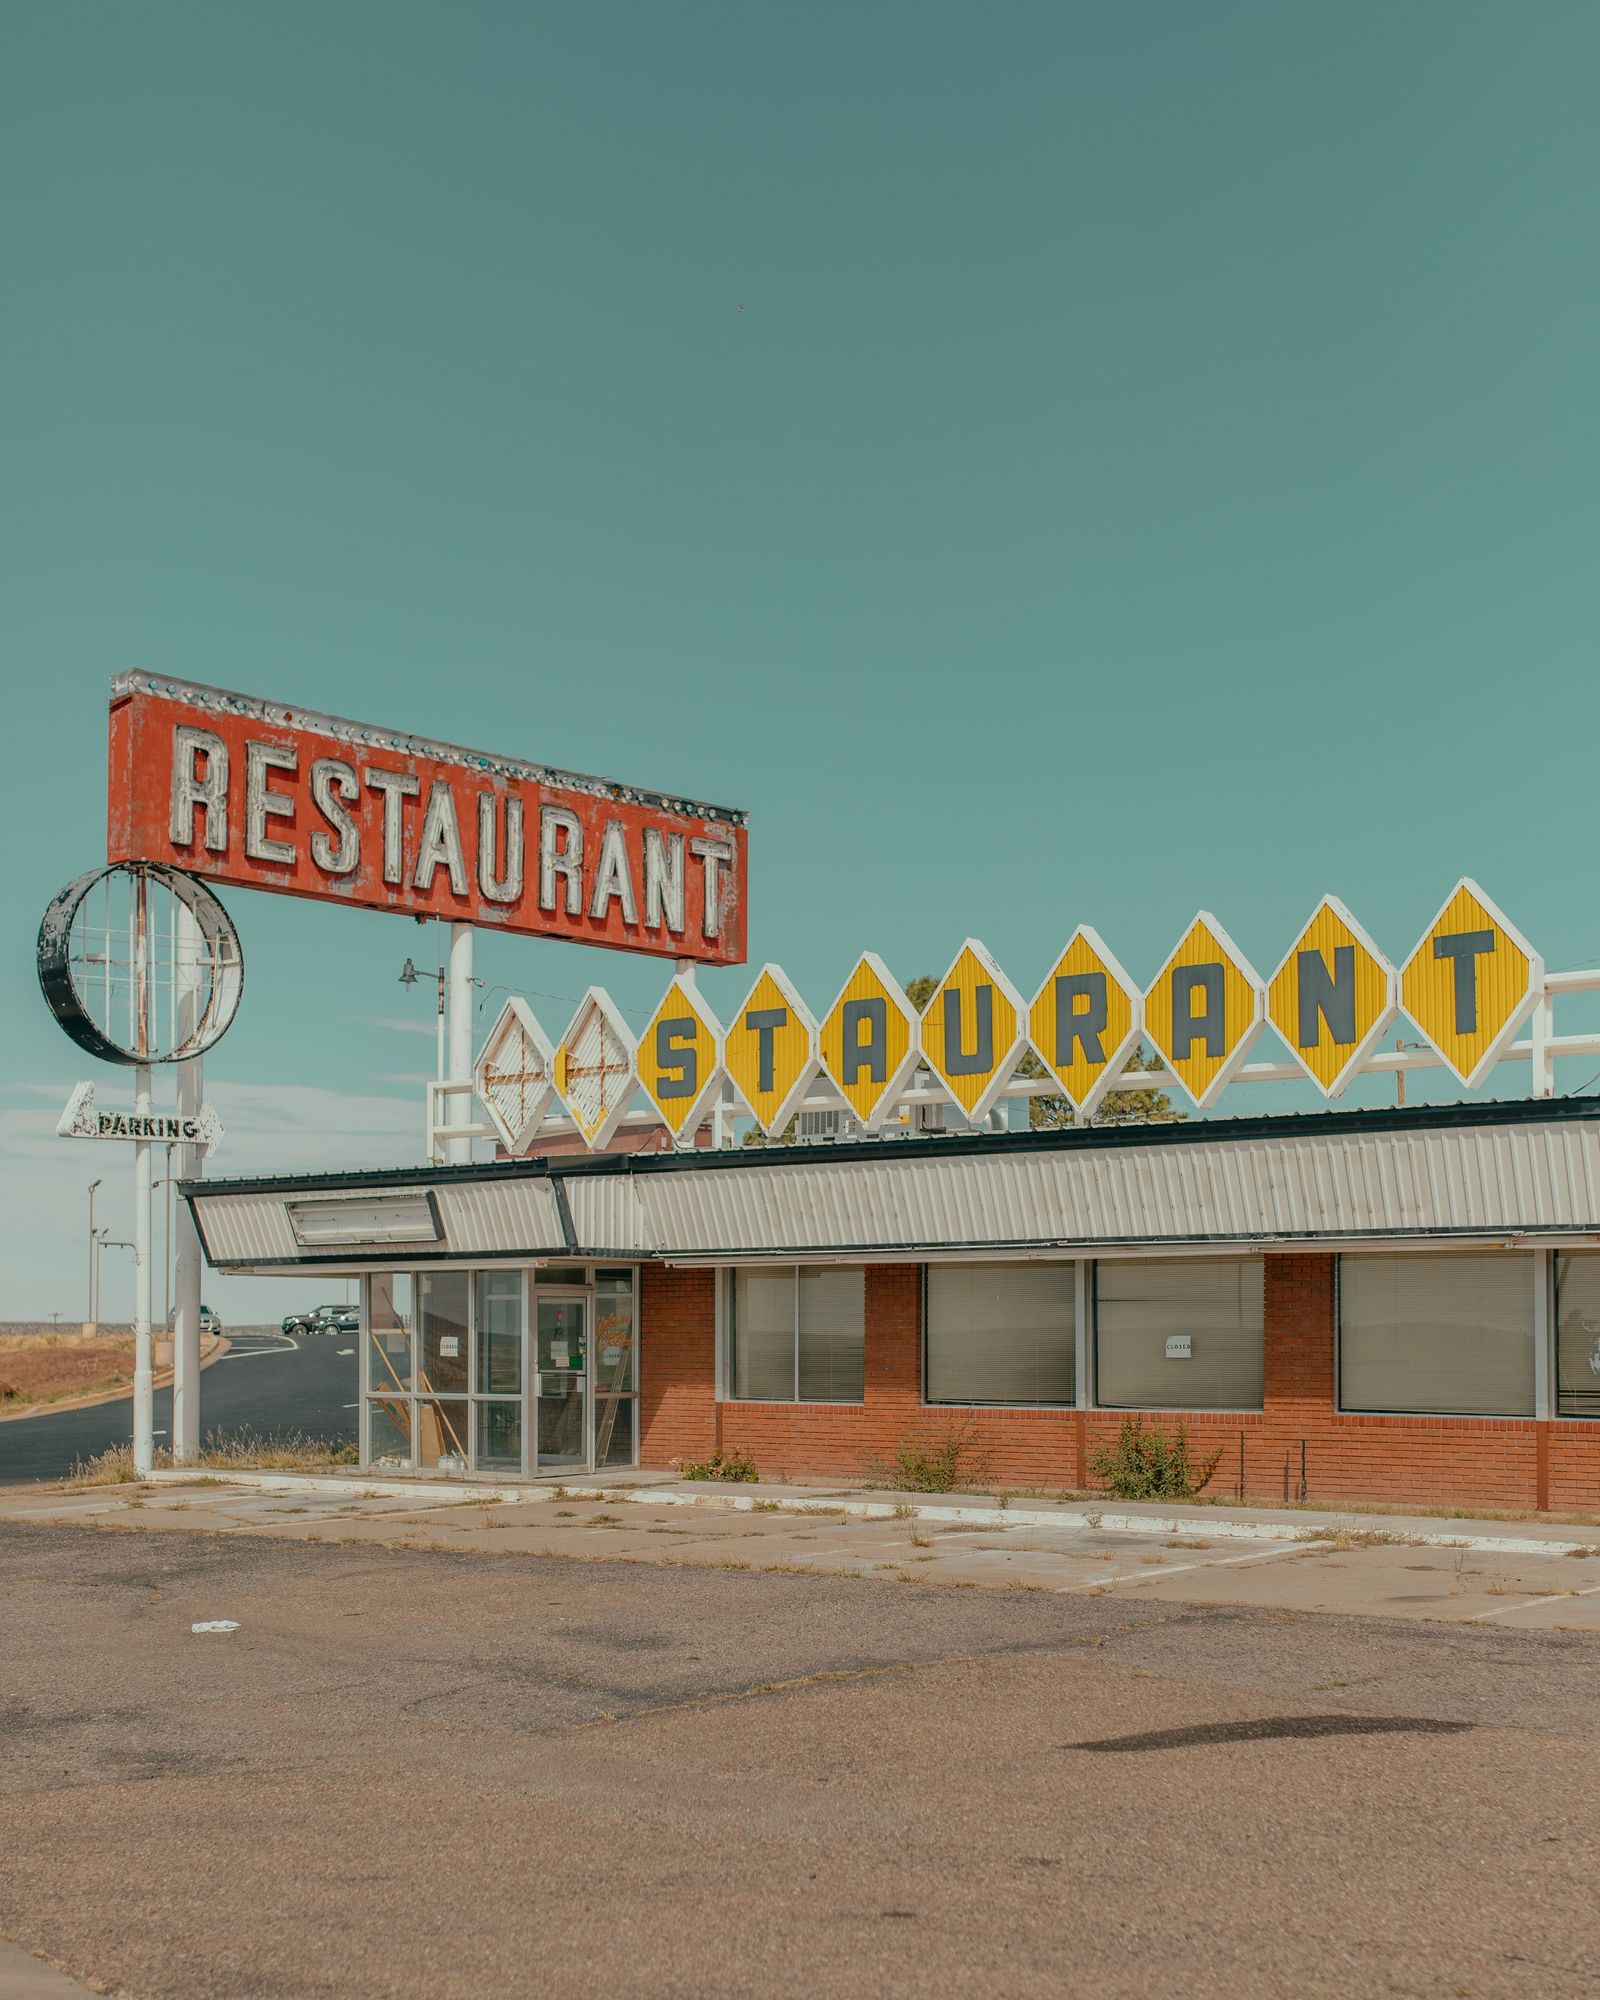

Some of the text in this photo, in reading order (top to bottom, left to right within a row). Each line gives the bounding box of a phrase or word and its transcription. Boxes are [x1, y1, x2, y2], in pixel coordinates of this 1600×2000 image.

[168, 723, 733, 939] RESTAURANT
[656, 929, 1495, 1099] STAURANT
[98, 1114, 199, 1138] PARKING
